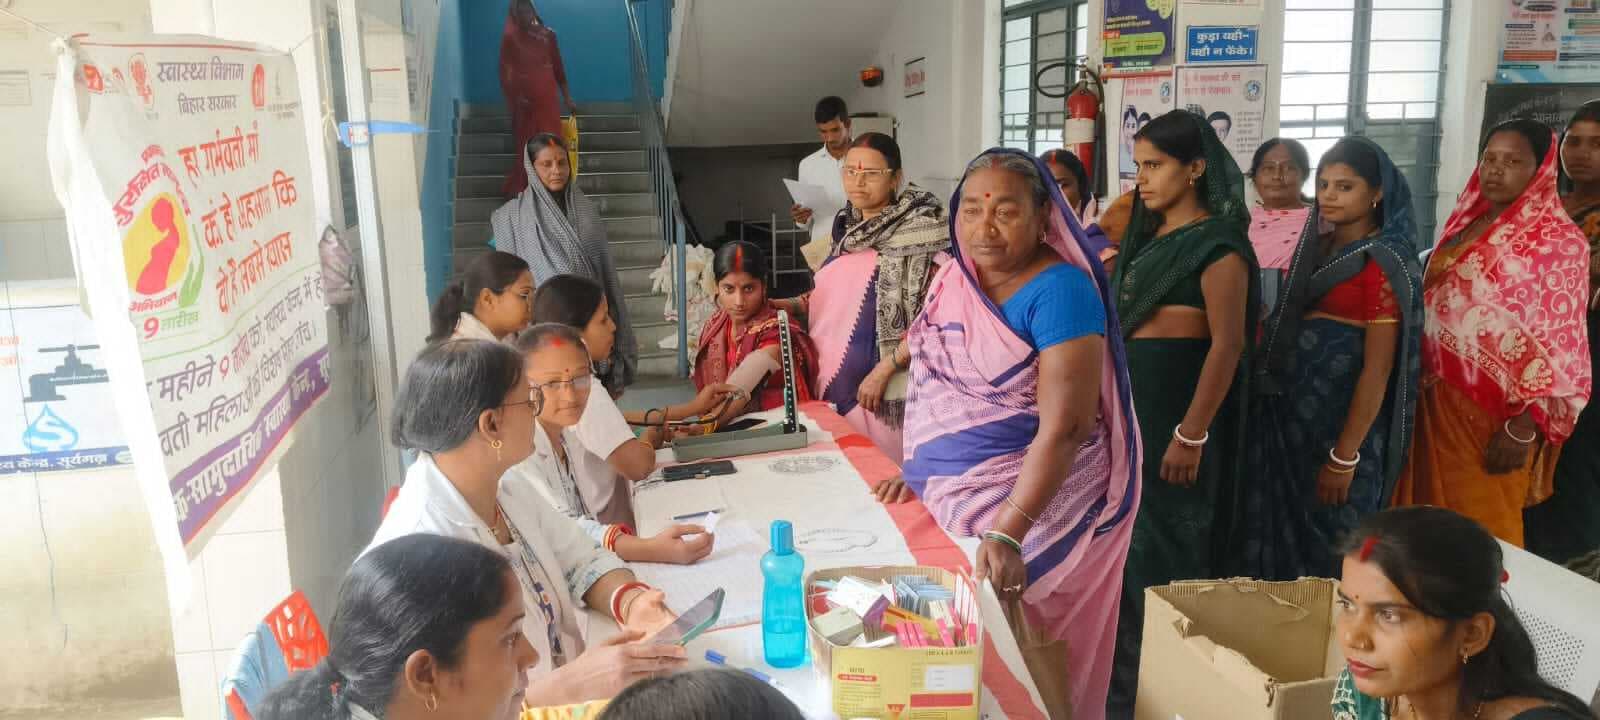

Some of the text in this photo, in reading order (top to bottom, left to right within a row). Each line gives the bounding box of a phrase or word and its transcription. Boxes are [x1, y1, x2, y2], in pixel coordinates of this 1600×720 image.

[1213, 47, 1223, 55] न
[157, 56, 244, 82] स्वास्थ्य विभाग
[178, 93, 238, 115] बिहार सरकार
[178, 146, 199, 188] हर
[272, 169, 297, 208] कि
[144, 316, 160, 340] 9
[156, 353, 216, 402] महीने
